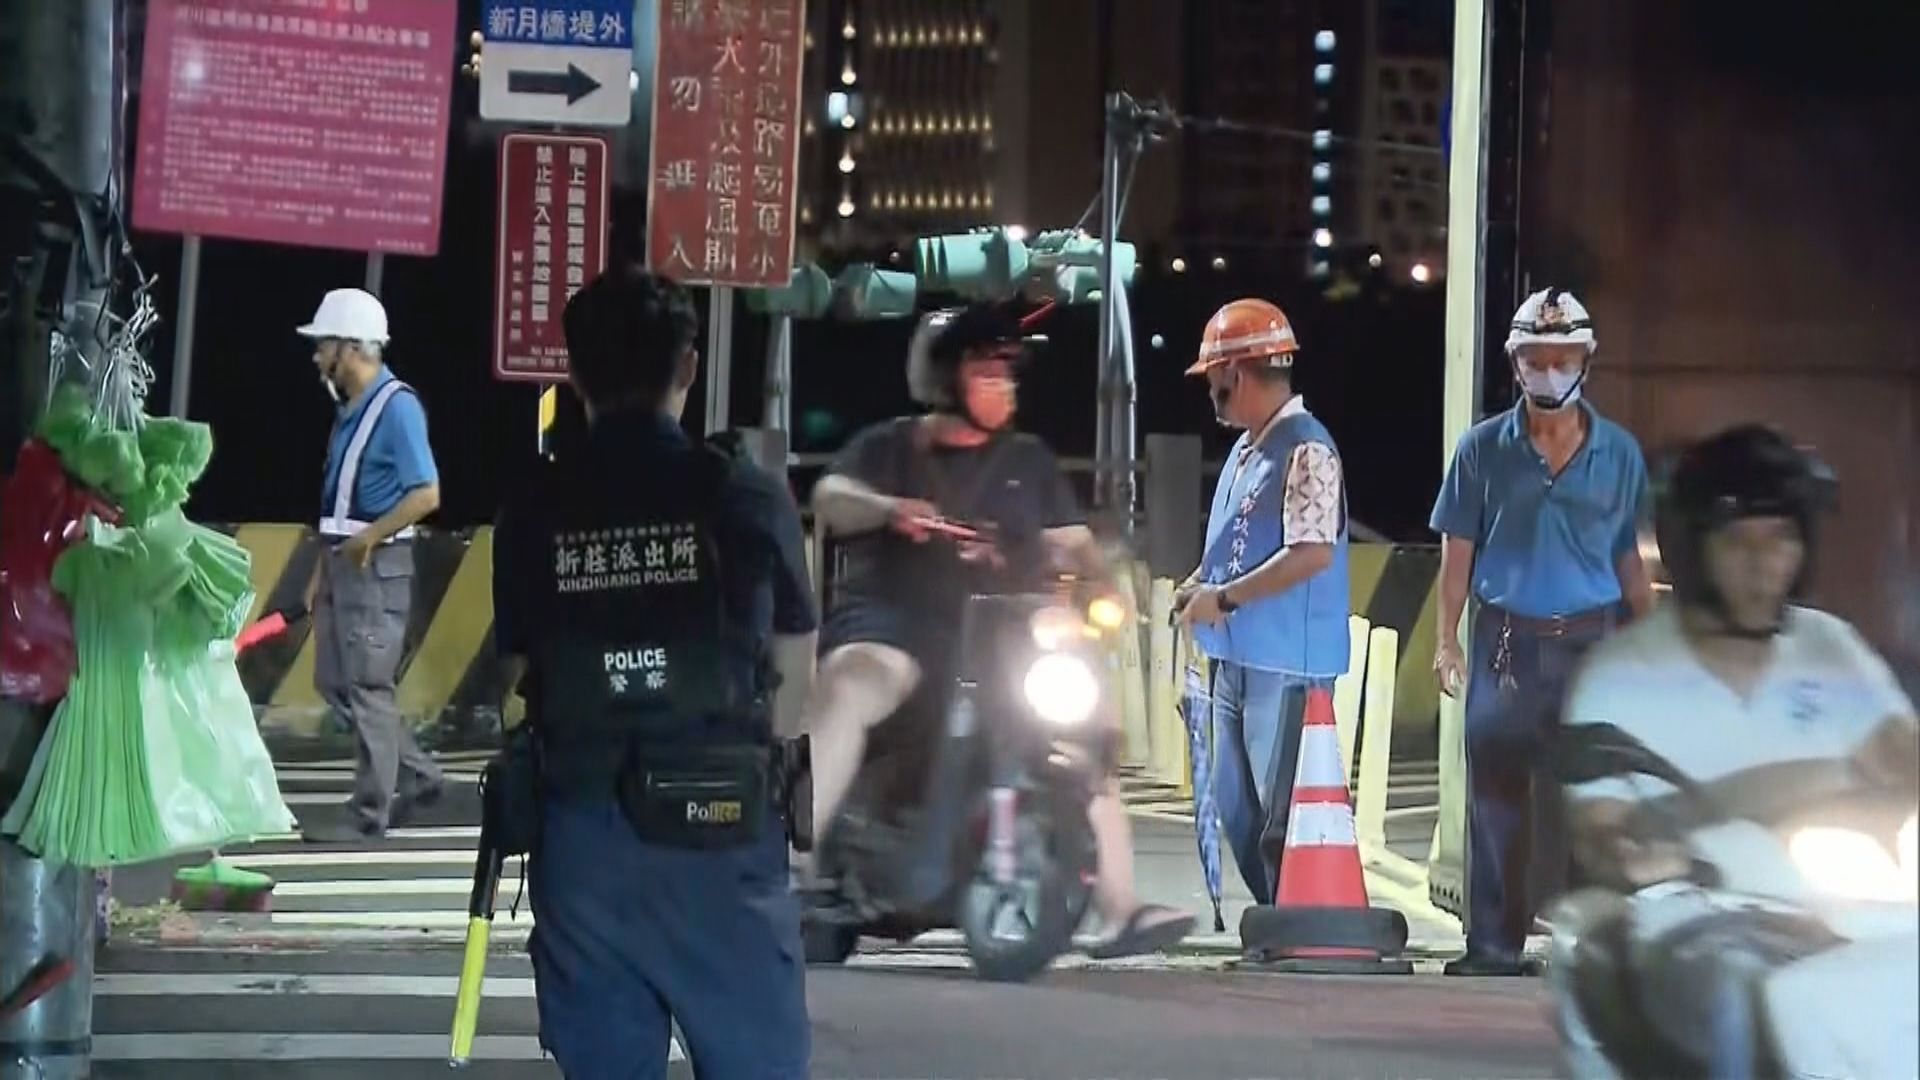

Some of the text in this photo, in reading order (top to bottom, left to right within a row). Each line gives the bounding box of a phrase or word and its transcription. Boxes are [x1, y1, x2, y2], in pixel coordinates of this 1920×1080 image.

[487, 5, 625, 43] 新月橋堤外
[556, 536, 698, 576] 新莊派出所
[557, 567, 699, 593] XINZHUANG POLICE
[604, 648, 667, 671] POLICE
